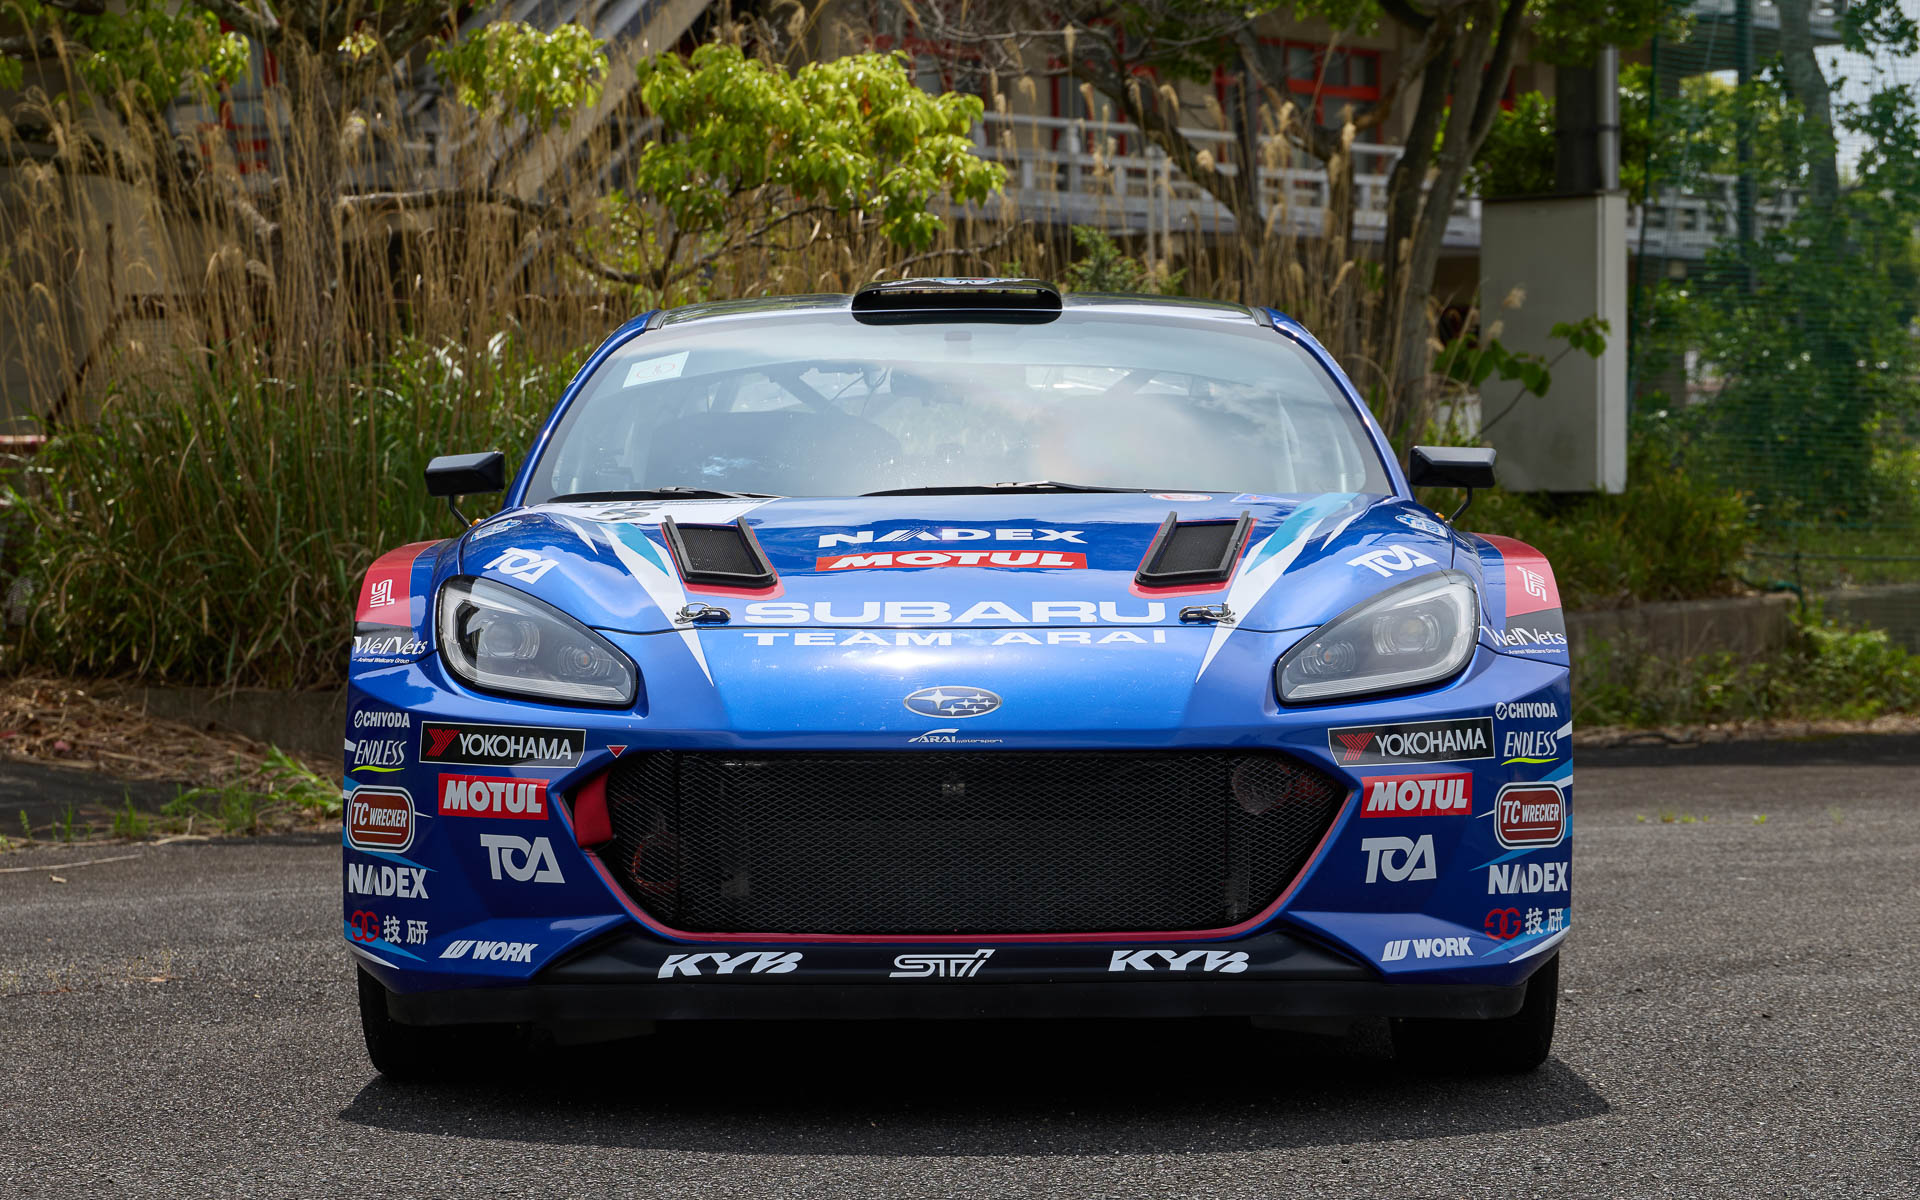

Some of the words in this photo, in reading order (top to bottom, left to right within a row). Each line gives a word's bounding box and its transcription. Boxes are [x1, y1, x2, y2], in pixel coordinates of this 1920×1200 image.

[818, 529, 1088, 548] NADEX
[483, 547, 559, 583] TOA
[828, 552, 1076, 569] MOTUL
[1346, 545, 1438, 578] TOA
[744, 601, 1166, 624] SUBARU
[743, 631, 953, 646] TEAM
[992, 630, 1166, 645] ARAI
[363, 711, 411, 728] CHIYODA
[1508, 702, 1558, 718] CHIYODA
[353, 739, 407, 766] ENDLESS
[459, 733, 572, 760] YOKOHAMA
[1375, 727, 1487, 757] YOKOHAMA
[1503, 730, 1557, 757] ENDLESS
[442, 780, 542, 814] MOTUL
[1366, 779, 1468, 812] MOTUL
[352, 802, 369, 826] TC
[369, 807, 407, 828] WRECKER
[1502, 800, 1521, 824] TC
[1521, 803, 1560, 823] WRECKER
[480, 834, 565, 883] TOA
[1361, 834, 1437, 884] TOA
[348, 863, 429, 899] NADEX
[1488, 862, 1569, 894] NADEX
[383, 915, 429, 945] 技研
[1525, 907, 1564, 935] 技研
[472, 941, 539, 963] WORK
[1108, 949, 1250, 974] KYB
[1413, 937, 1474, 959] WORK
[657, 951, 804, 979] KYB
